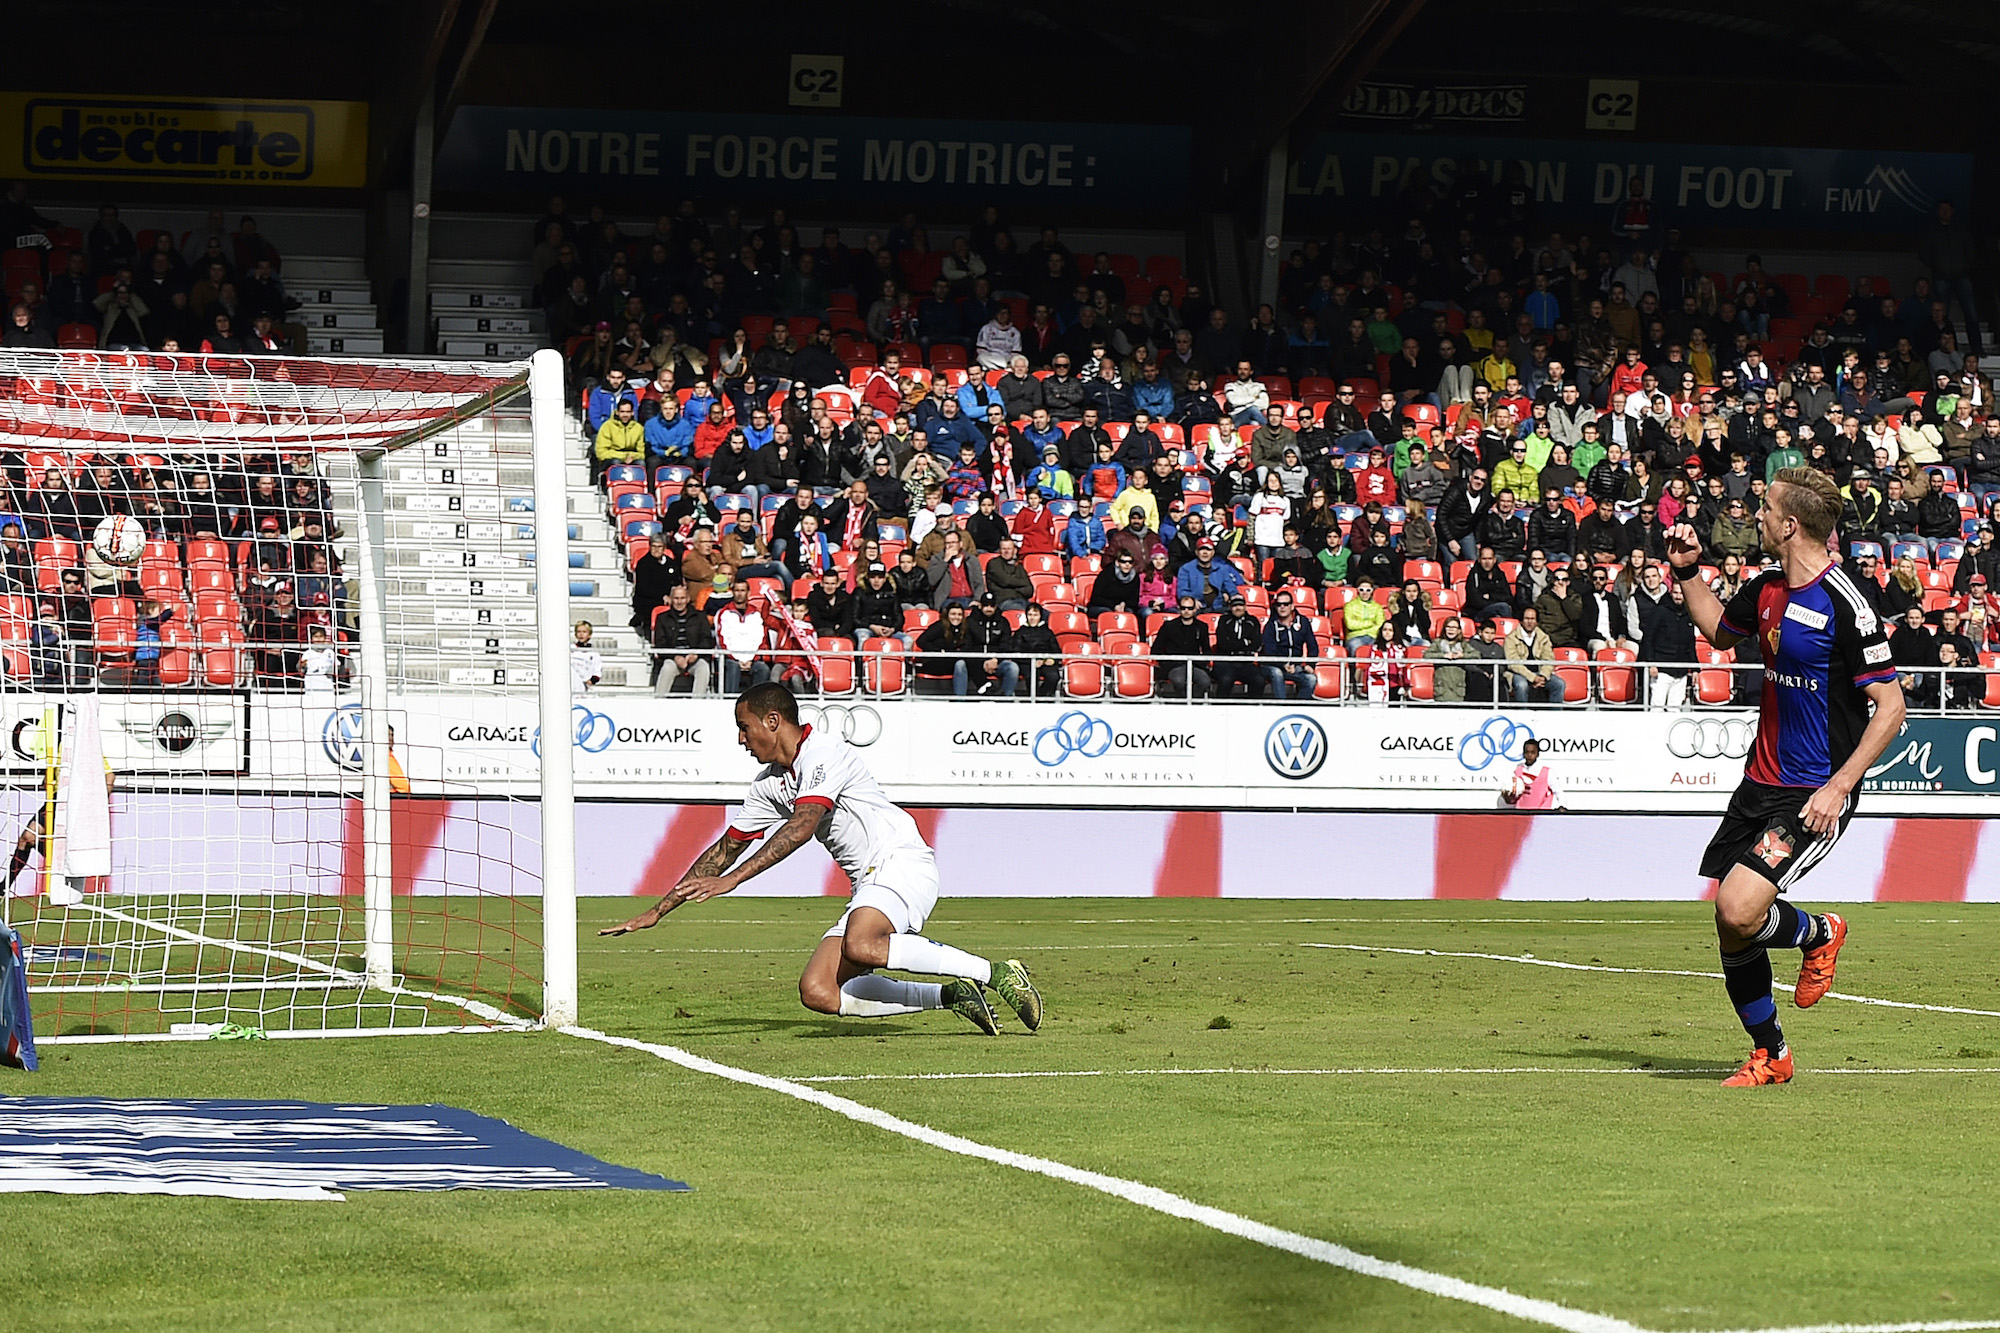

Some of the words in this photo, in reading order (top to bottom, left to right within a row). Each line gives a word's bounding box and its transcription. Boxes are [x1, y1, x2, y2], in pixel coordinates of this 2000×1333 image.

[794, 68, 837, 92] C2
[1434, 88, 1526, 117] DOCS
[1592, 93, 1633, 116] C2
[87, 112, 180, 128] meubles
[36, 109, 301, 167] decarte
[506, 129, 660, 177] NOTRE
[686, 134, 839, 182] FORCE
[218, 169, 283, 180] saxon
[1288, 155, 1345, 197] LA
[1371, 156, 1567, 203] PASIN
[1594, 162, 1655, 206] DU
[1679, 165, 1793, 211] FOOT
[1825, 187, 1883, 214] FMV
[1764, 668, 1818, 691] NOVARTIS
[158, 725, 194, 738] MINI
[448, 726, 528, 741] GARAGE
[617, 727, 702, 744] OLYMPIC
[952, 731, 1029, 746] GARAGE
[1115, 733, 1196, 749] OLYMPIC
[1380, 736, 1454, 751] GARAGE
[1538, 738, 1615, 753] OLYMPIC
[447, 766, 513, 775] SIERRE
[607, 768, 703, 777] MARTIGNY
[951, 769, 1015, 779] SIERRE
[1104, 771, 1196, 781] MARTIGNY
[1379, 774, 1441, 783] SIERRE
[1670, 772, 1716, 785] Audi
[1881, 781, 1932, 791] MONTANA
